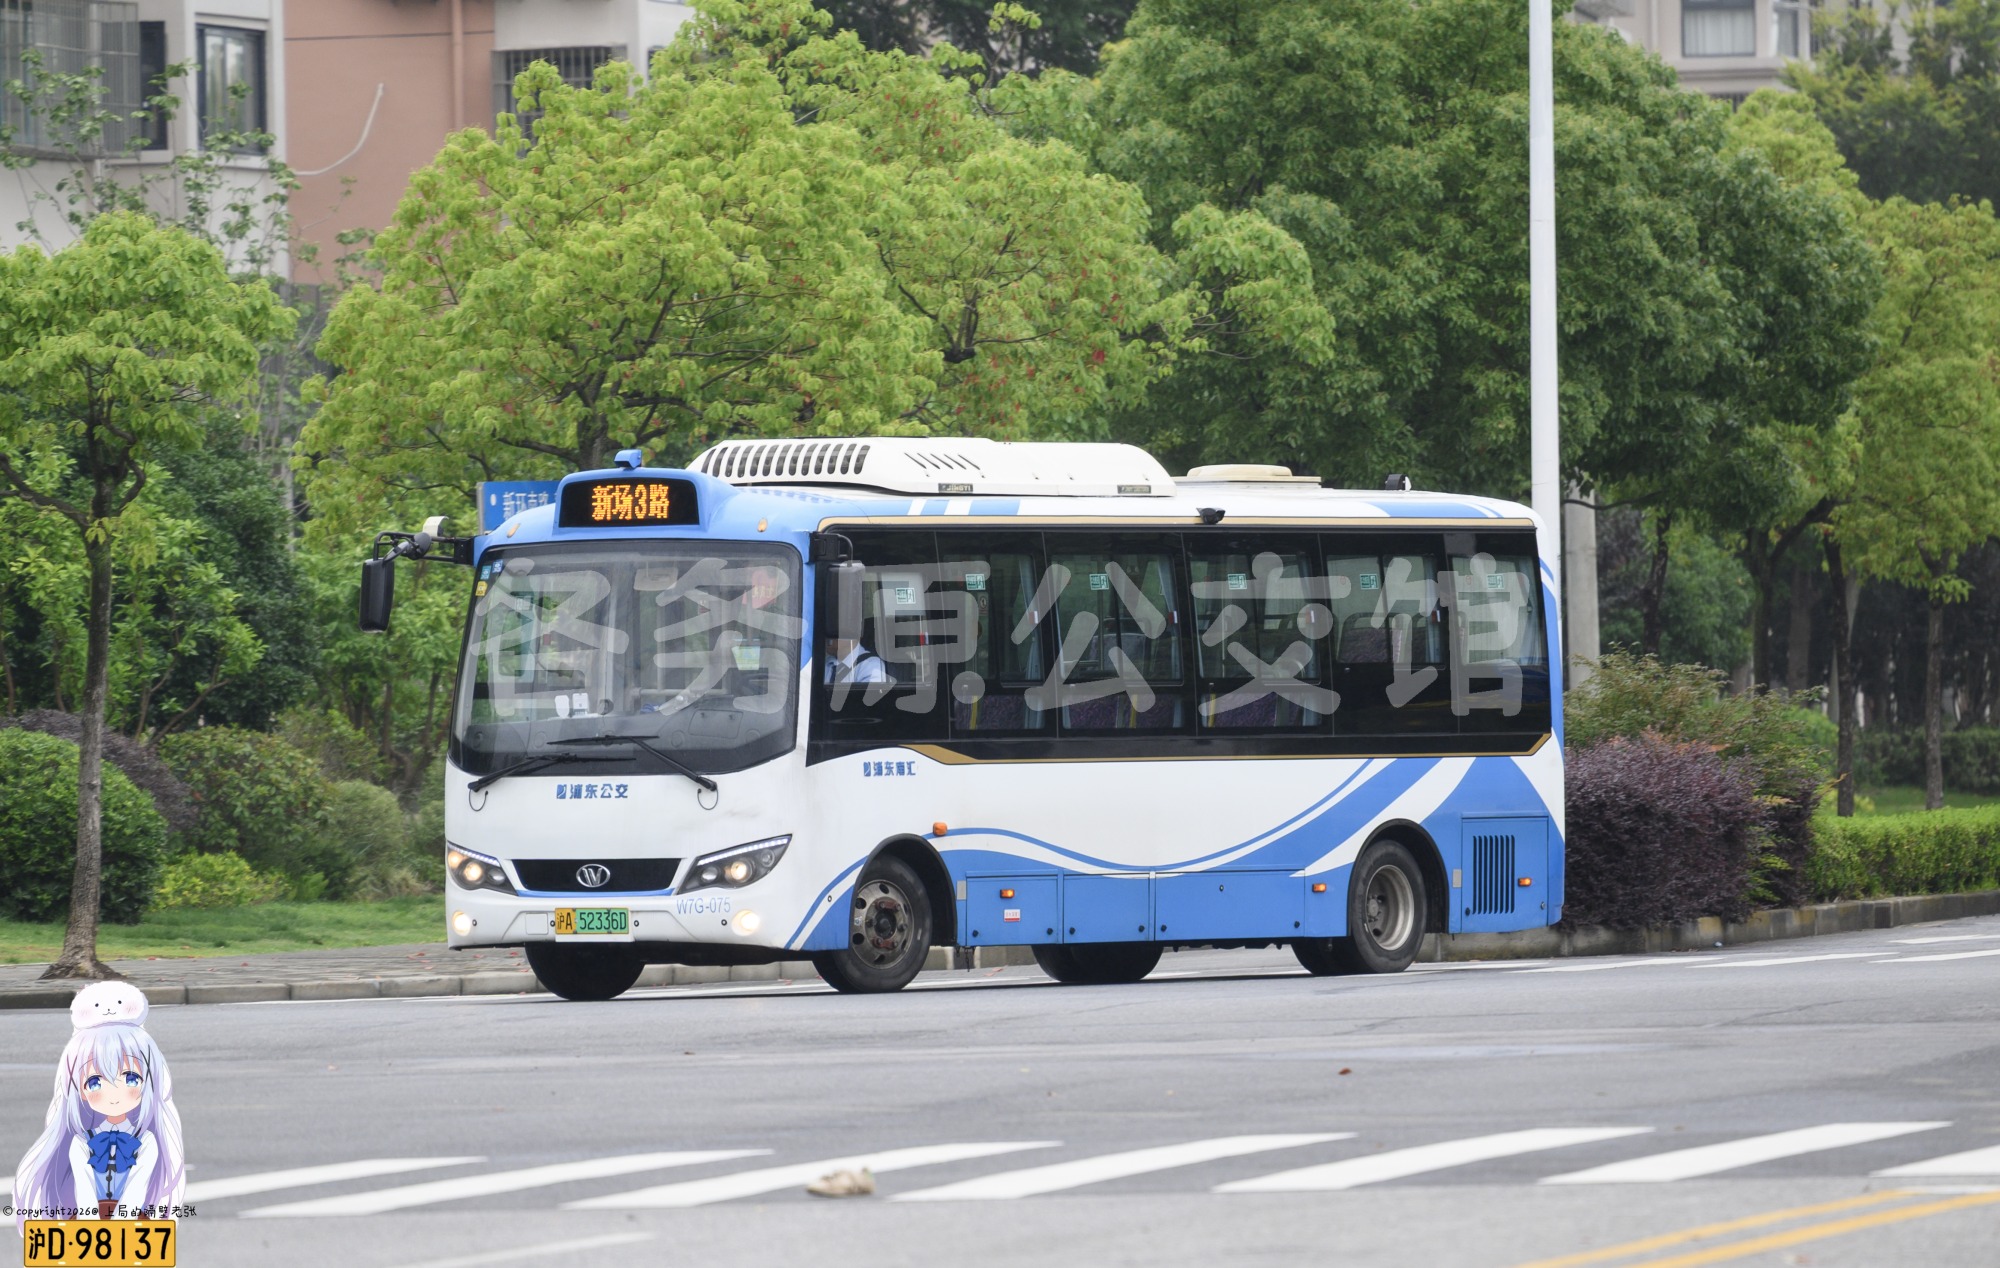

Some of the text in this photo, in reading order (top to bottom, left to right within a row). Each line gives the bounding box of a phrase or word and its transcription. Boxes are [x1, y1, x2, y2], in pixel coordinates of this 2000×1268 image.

[592, 484, 669, 520] 新场3路
[569, 783, 629, 799] 浦东公交
[676, 897, 731, 915] W7G-075
